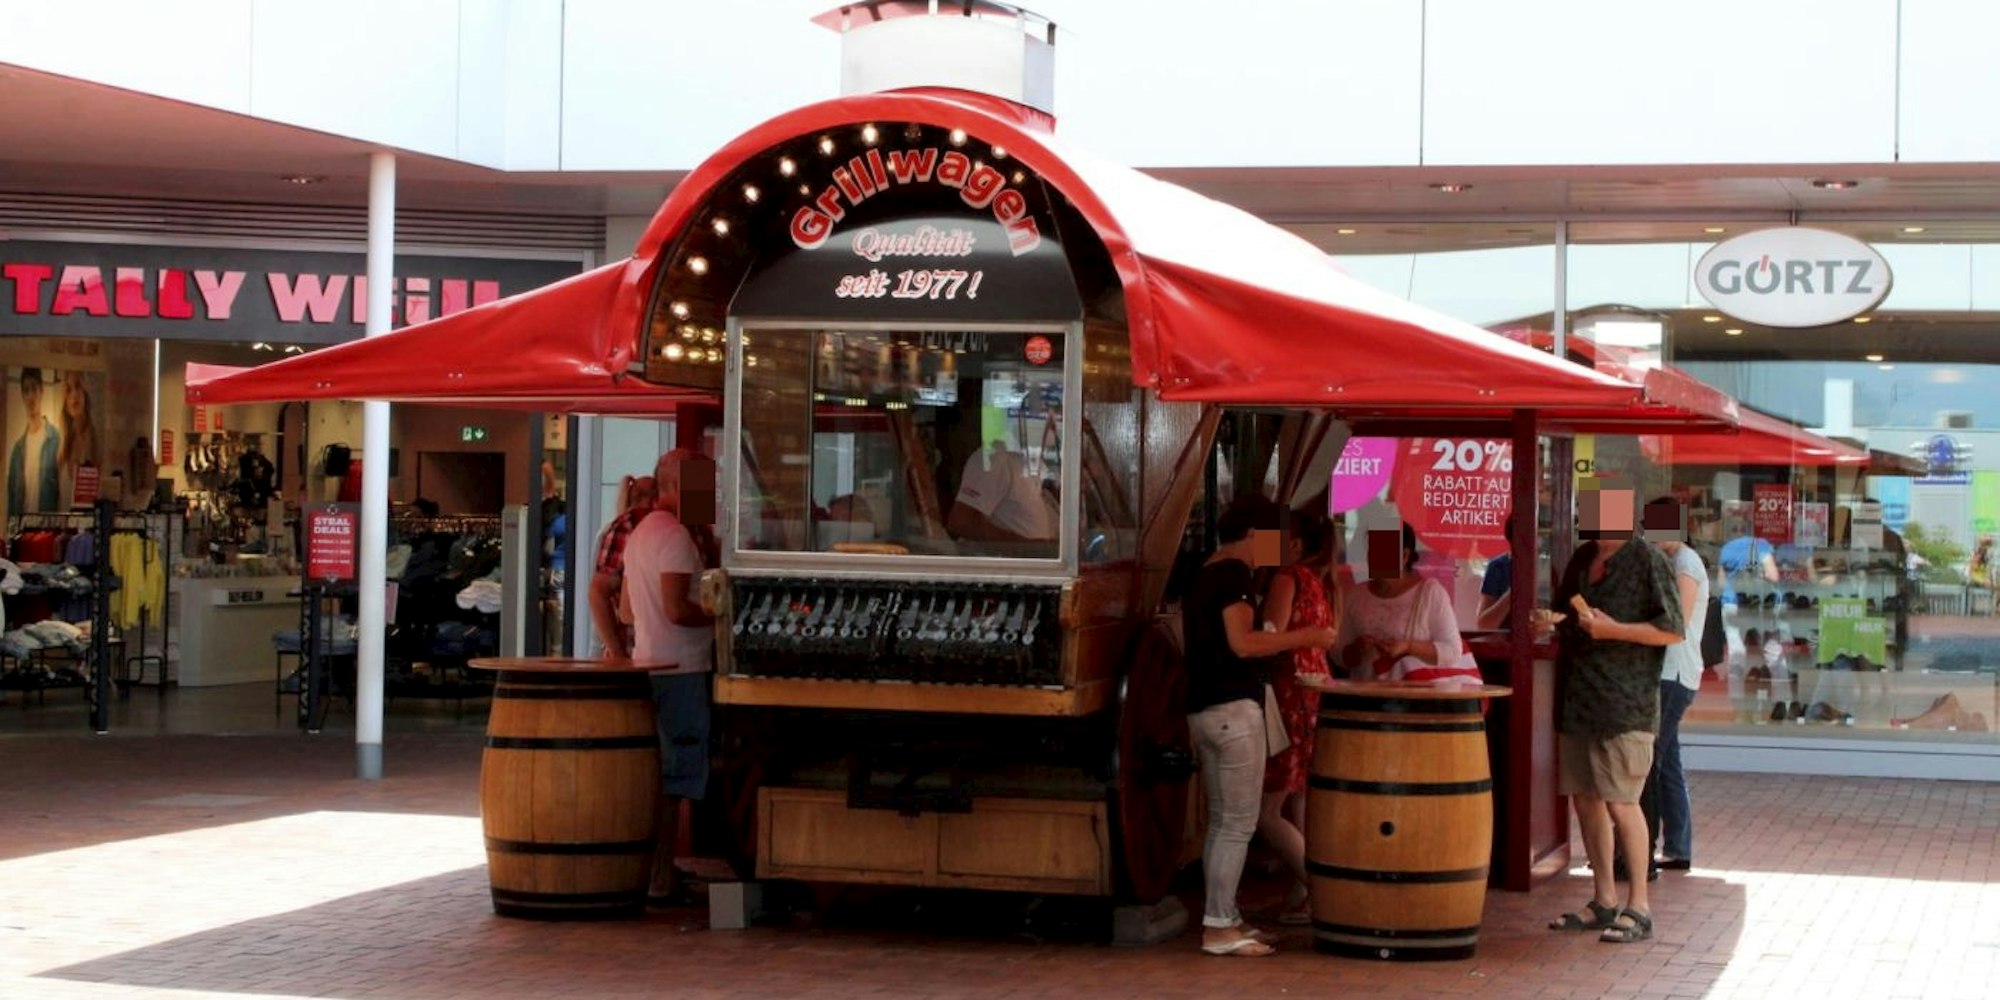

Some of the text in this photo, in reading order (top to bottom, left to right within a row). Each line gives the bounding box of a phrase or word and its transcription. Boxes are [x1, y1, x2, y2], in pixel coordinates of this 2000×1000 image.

[790, 148, 1041, 257] Grillwagen
[852, 224, 977, 262] Qualität
[3, 263, 248, 320] TALLY
[835, 269, 891, 299] seit
[1333, 457, 1382, 476] ZIERT
[1432, 438, 1513, 473] 20%
[1423, 475, 1483, 492] RABATT
[313, 516, 351, 526] STEAL
[313, 526, 351, 534] DEALS
